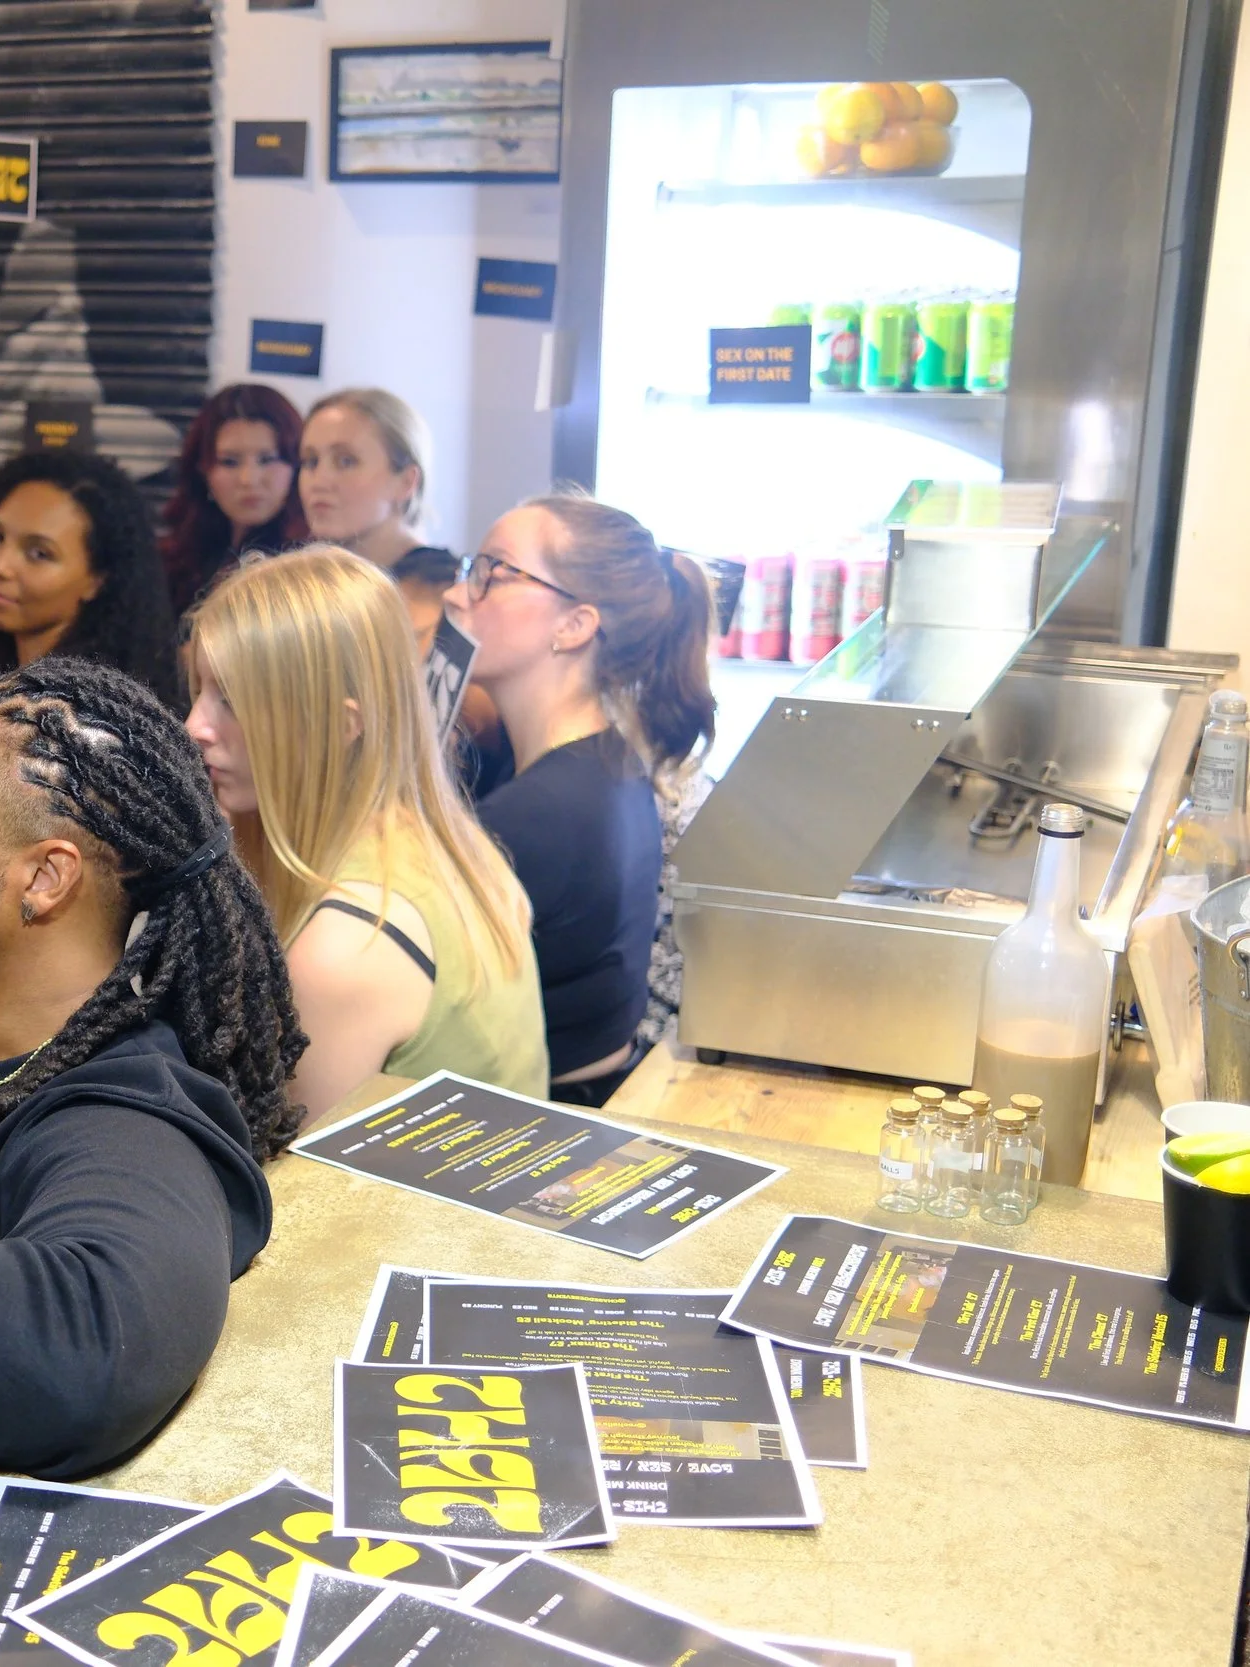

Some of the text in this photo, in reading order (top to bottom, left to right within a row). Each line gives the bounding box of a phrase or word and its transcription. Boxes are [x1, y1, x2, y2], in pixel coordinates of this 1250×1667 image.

[716, 346, 793, 363] SEX ON THE
[716, 366, 792, 382] FIRST DATE
[393, 1374, 544, 1533] THAT
[636, 1460, 672, 1472] SEX
[687, 1462, 733, 1473] LOVE
[625, 1480, 667, 1490] DRINK
[621, 1499, 668, 1512] THIS
